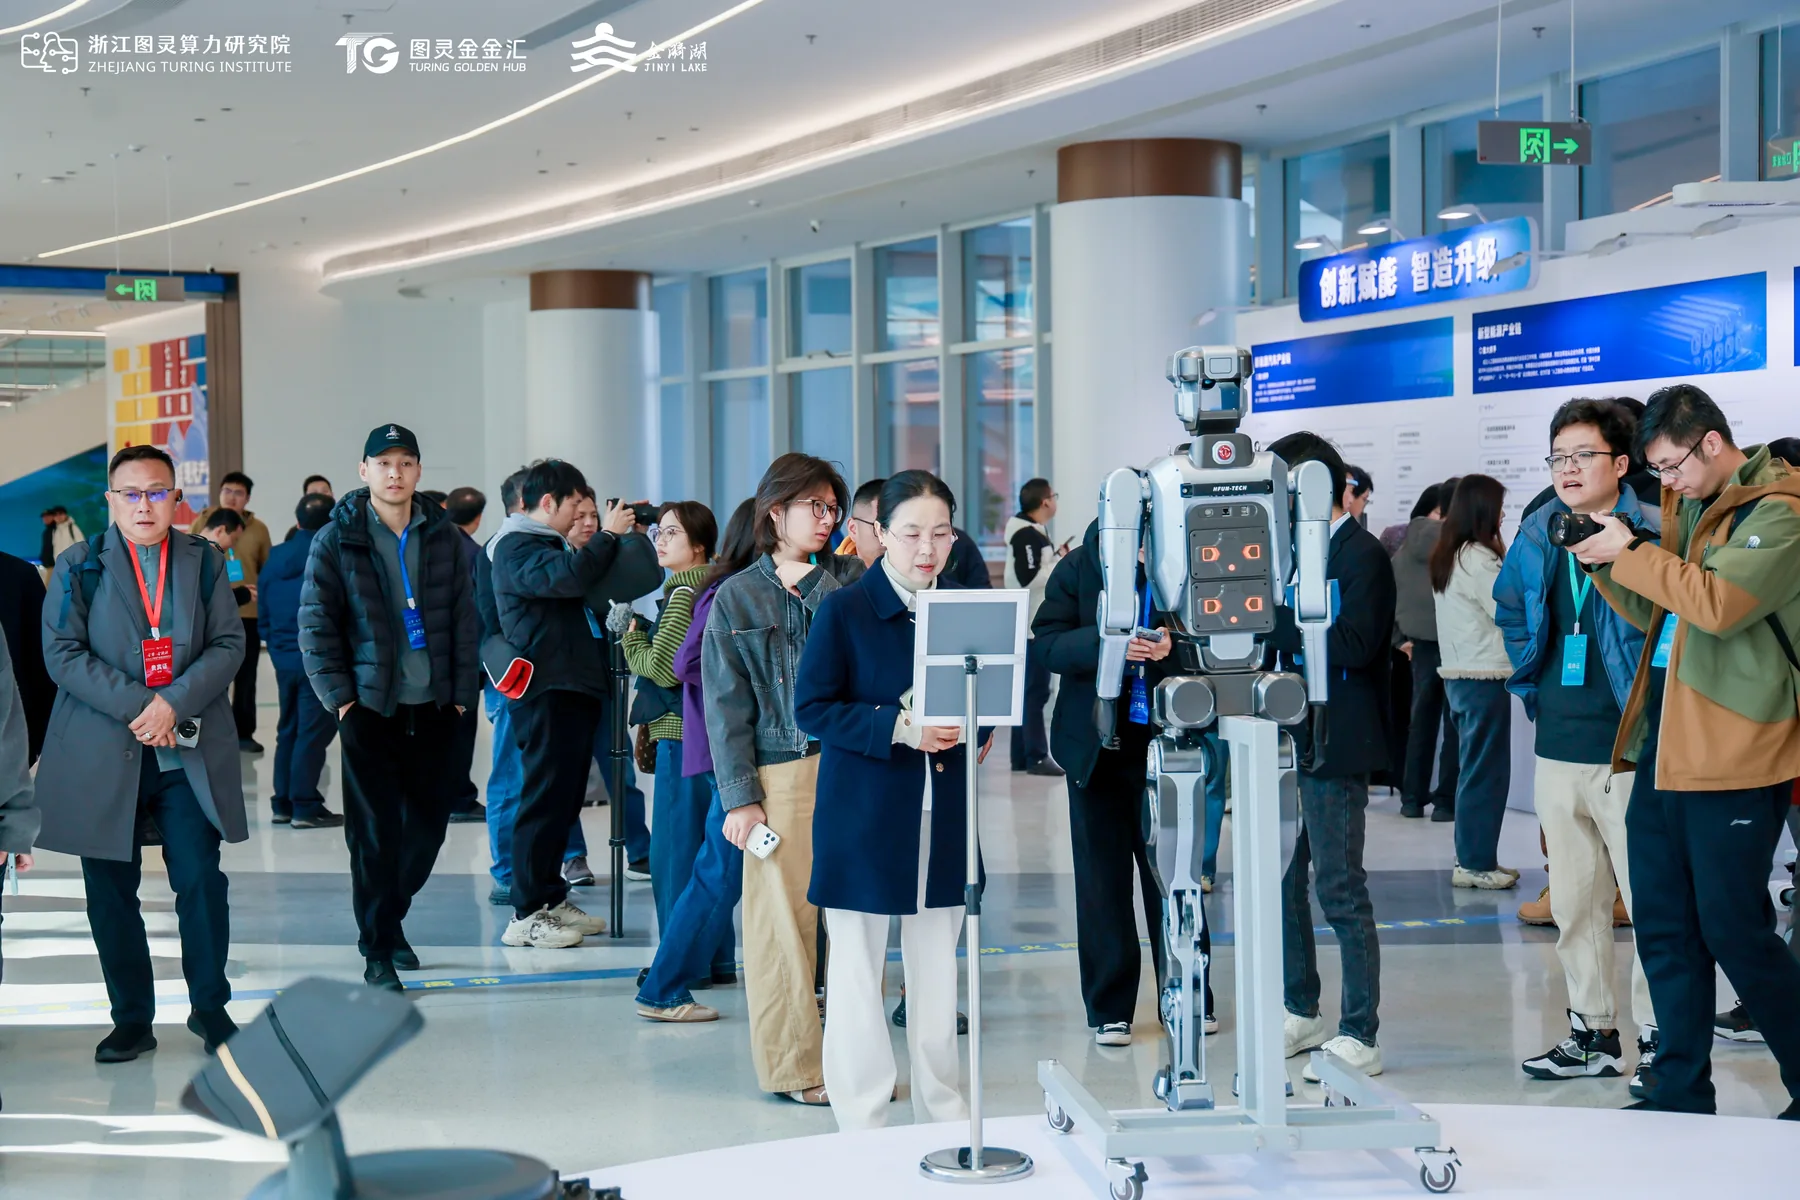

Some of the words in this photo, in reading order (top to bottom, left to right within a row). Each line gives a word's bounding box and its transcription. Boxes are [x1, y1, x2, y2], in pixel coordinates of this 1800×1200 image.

[1319, 256, 1399, 309] 创新赋能
[1410, 236, 1500, 293] 智造升级
